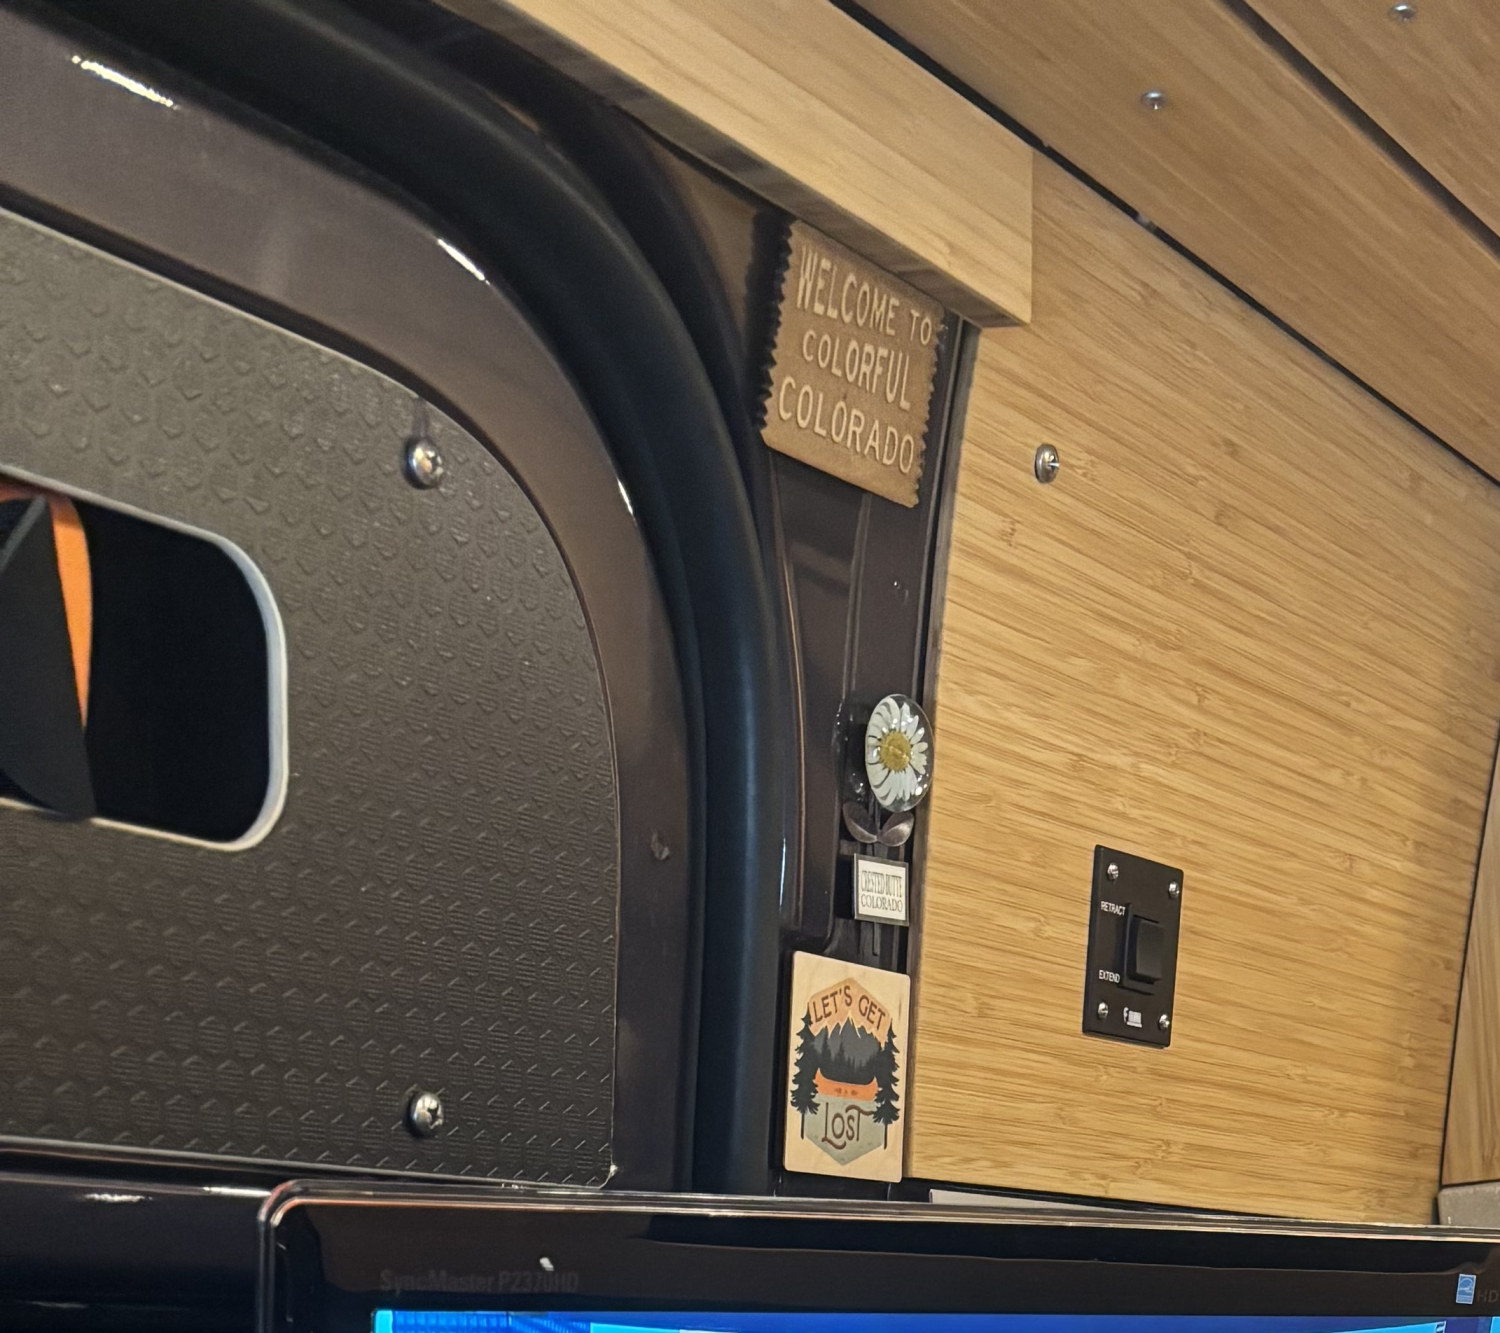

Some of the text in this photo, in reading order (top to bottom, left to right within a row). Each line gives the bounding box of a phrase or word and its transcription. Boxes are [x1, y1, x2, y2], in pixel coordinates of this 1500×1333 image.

[796, 247, 932, 345] WELCOME TO
[803, 329, 911, 411] COLORFUL
[778, 376, 915, 474] COLORADO
[860, 893, 904, 913] COLORADO
[1101, 901, 1126, 916] RETRACT
[1099, 970, 1120, 983] EXTEND
[812, 985, 887, 1030] LET'S GET
[379, 1268, 494, 1296] SyncMaster
